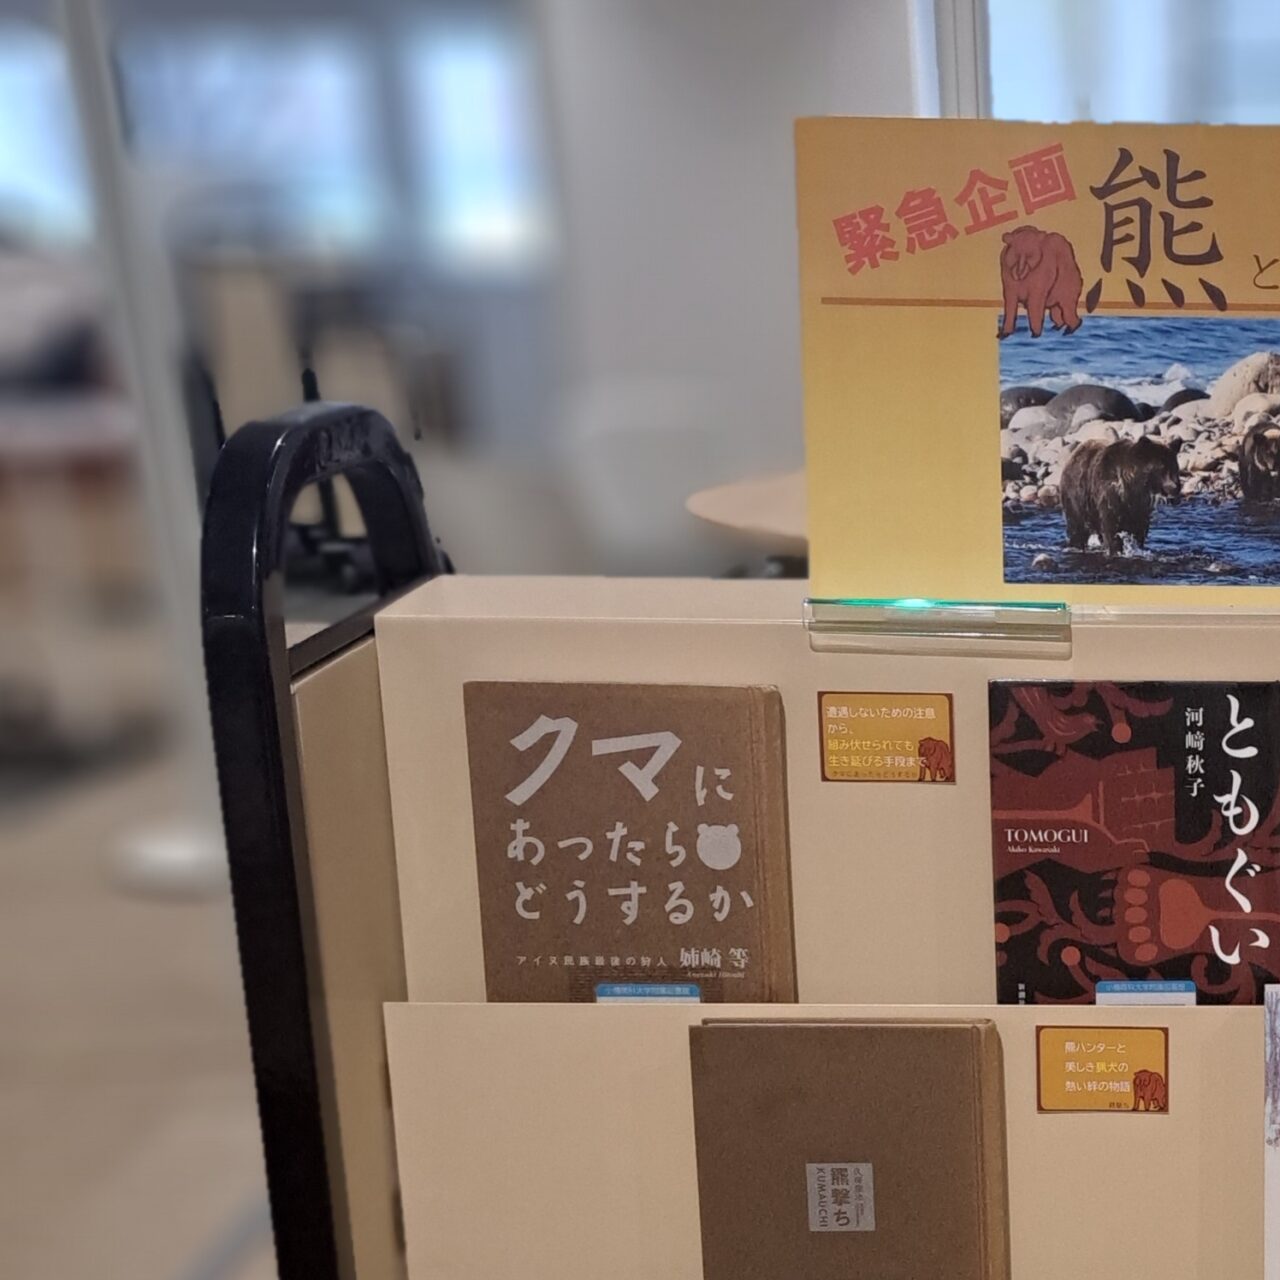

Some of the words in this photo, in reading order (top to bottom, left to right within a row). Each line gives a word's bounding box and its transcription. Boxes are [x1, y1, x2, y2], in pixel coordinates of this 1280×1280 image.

[832, 144, 1077, 276] 緊急企画
[1086, 147, 1227, 312] 熊
[504, 714, 735, 806] クマに
[828, 739, 914, 751] 組み伏せられても
[507, 818, 687, 868] あったら
[1004, 828, 1089, 844] TOMOGUI
[1208, 693, 1271, 966] ともぐい
[515, 879, 755, 926] どうするか
[816, 1166, 828, 1228] KUMAUCHI
